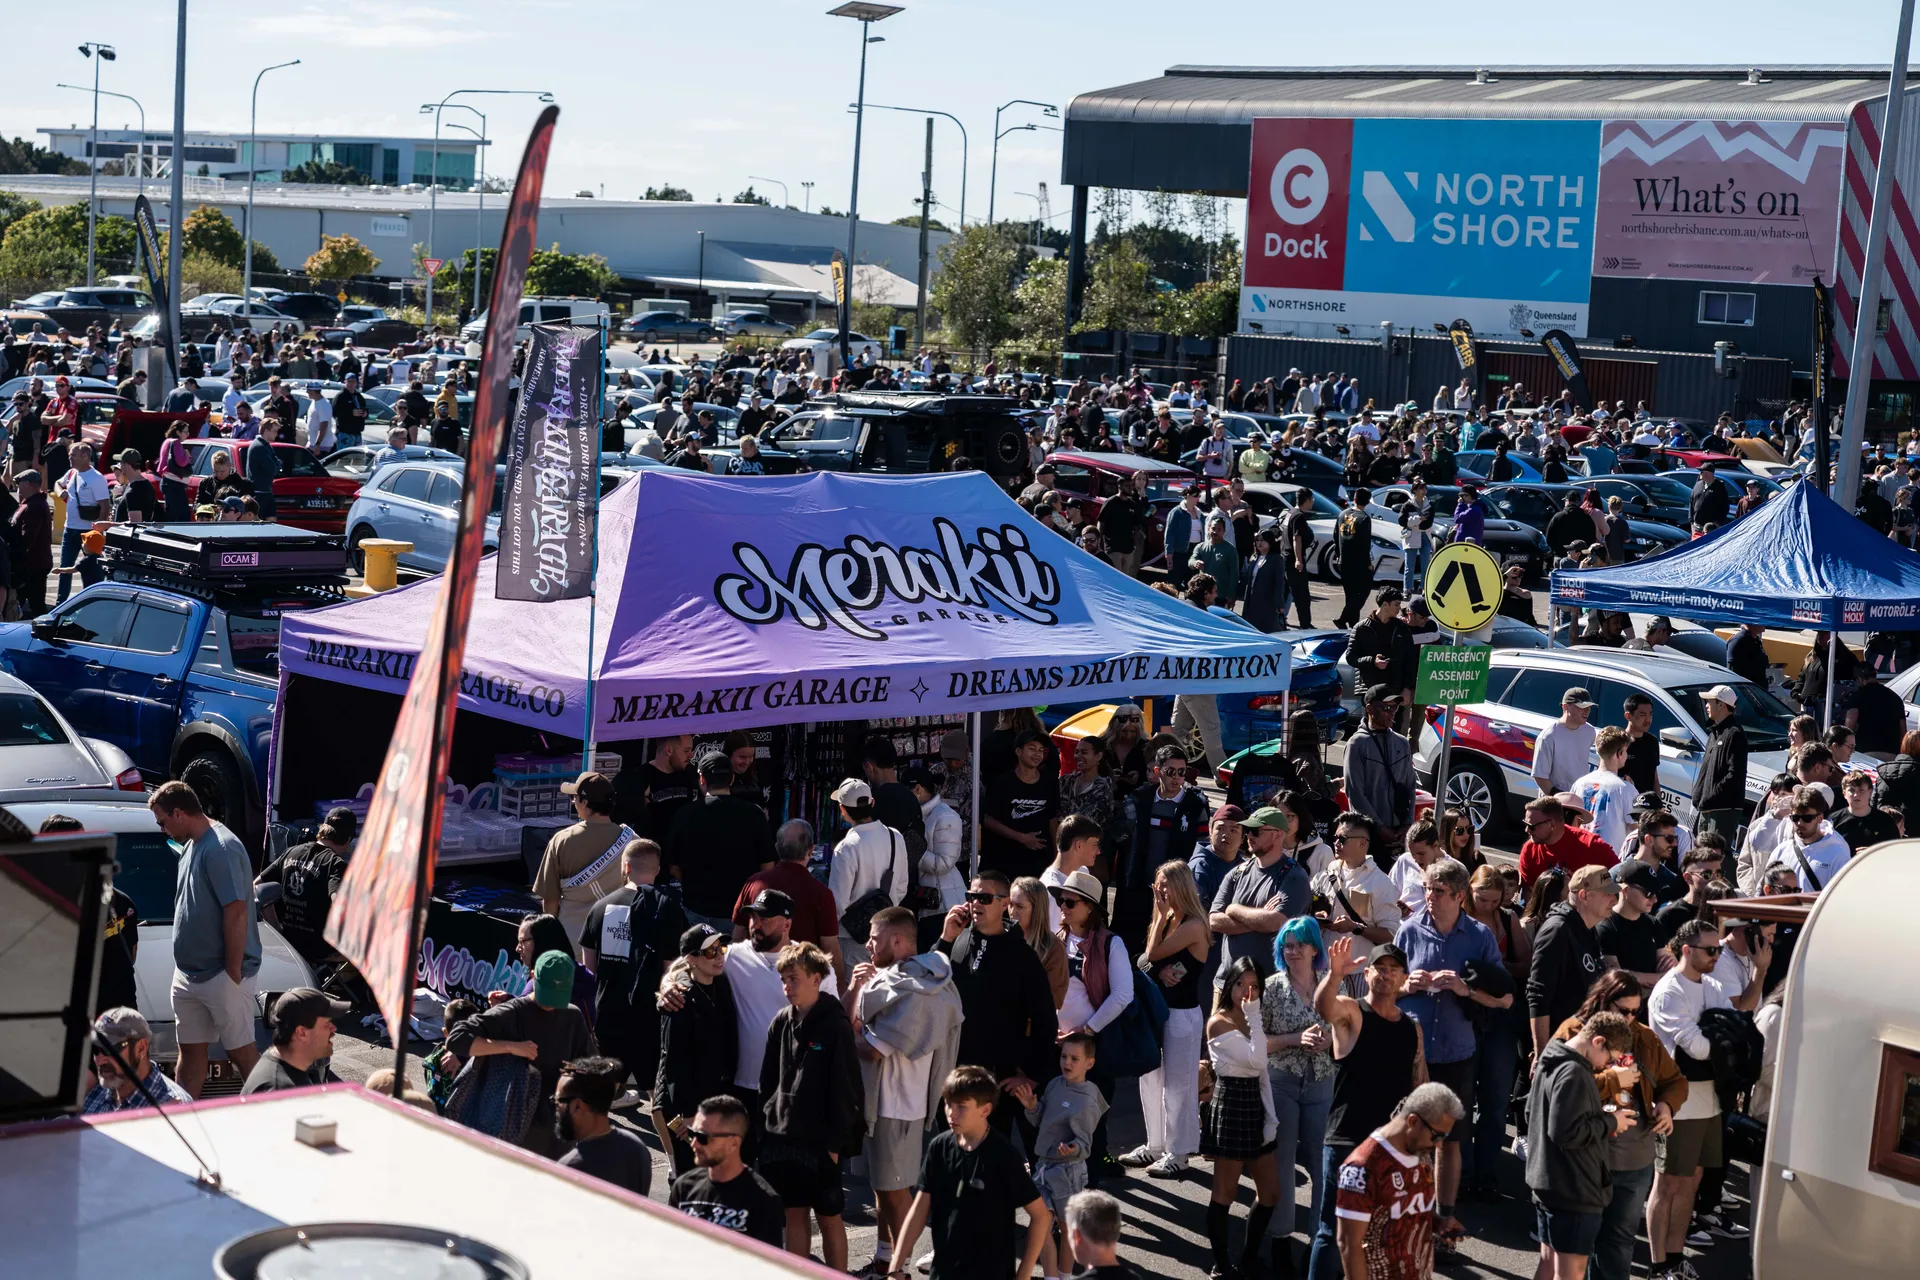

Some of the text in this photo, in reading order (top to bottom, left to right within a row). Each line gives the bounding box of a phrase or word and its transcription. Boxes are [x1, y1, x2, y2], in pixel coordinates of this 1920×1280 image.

[1283, 164, 1314, 209] C
[1435, 173, 1584, 208] NORTH
[1632, 176, 1801, 216] What's on
[1432, 212, 1580, 249] SHORE
[1621, 222, 1809, 240] northshorebrisbane.com.au/whats-on
[1264, 232, 1328, 259] Dock
[1269, 299, 1346, 312] NORTHSHORE
[1533, 311, 1577, 321] Queensland
[1533, 322, 1576, 331] Government
[523, 347, 547, 402] REMEMBER
[520, 403, 528, 416] TO
[517, 418, 527, 443] STAY
[513, 444, 524, 494] FOCUSED
[577, 392, 590, 540] DREAMS DRIVE AMBITION
[513, 502, 522, 524] YOU
[513, 525, 522, 548] GOT
[224, 555, 249, 564] OCAM
[511, 550, 520, 575] THIS
[714, 517, 1061, 641] Merakii
[1560, 578, 1585, 588] LIQUI
[1560, 588, 1585, 598] MOLY
[1630, 589, 1744, 610] www.liqui-moly.com
[1794, 600, 1821, 611] LIQUI
[1844, 602, 1864, 611] LIQUI
[1869, 602, 1917, 618] MOTORÖLE
[891, 607, 1009, 626] GARAGE
[1793, 610, 1821, 620] MOLY
[1844, 612, 1864, 622] MOLY
[1426, 651, 1486, 662] EMERGENCY
[305, 637, 565, 717] MERAKIIRAGE.CO
[1429, 670, 1480, 681] ASSEMBLY
[607, 653, 1282, 723] MERAKII GARAGE DREAMS DRIVE AMBITION
[1440, 689, 1470, 699] POINT
[25, 776, 63, 784] Cayman
[1660, 790, 1681, 806] OILS
[571, 872, 590, 887] THREE
[590, 852, 612, 874] STRIPES
[614, 838, 627, 851] THE
[606, 926, 631, 935] NORTH
